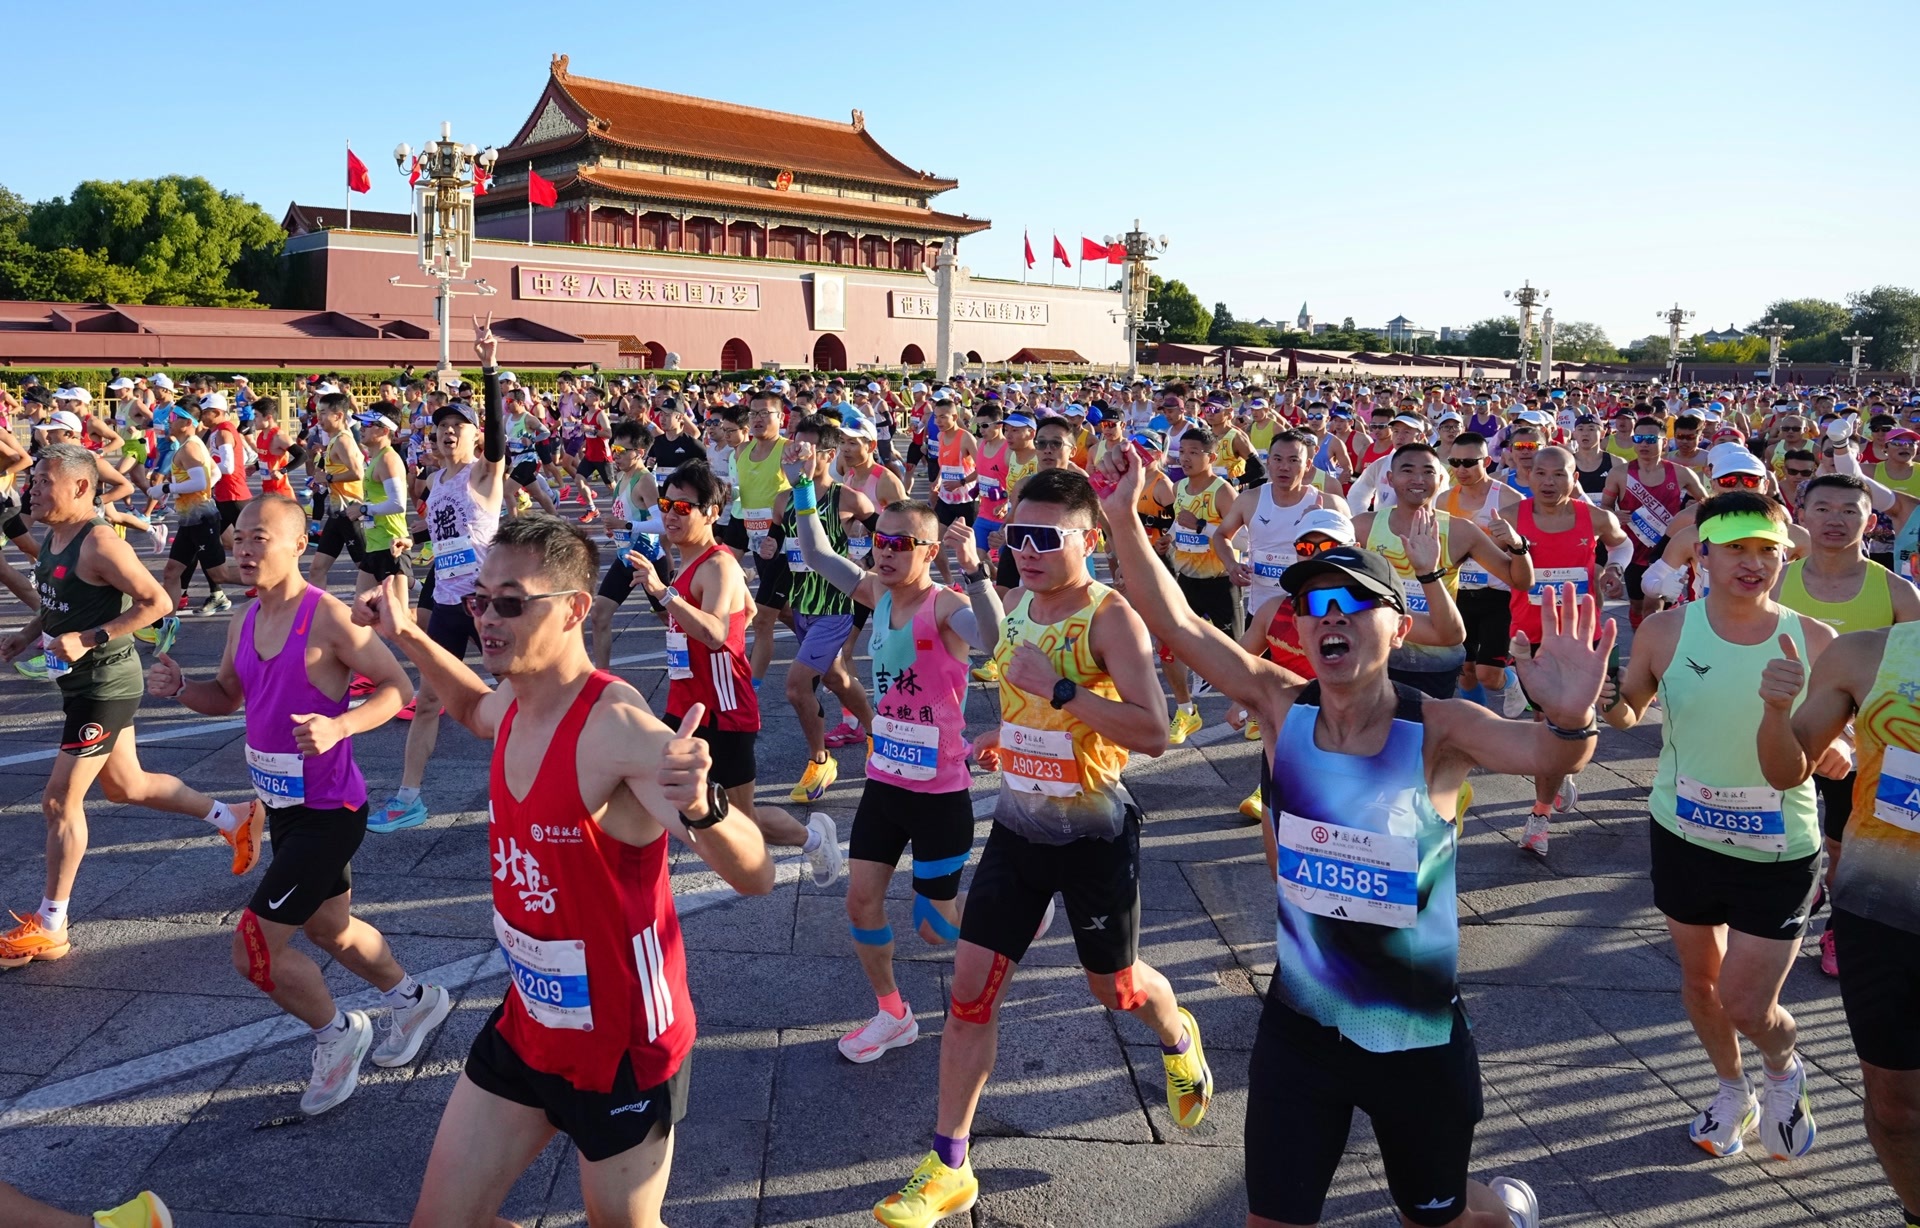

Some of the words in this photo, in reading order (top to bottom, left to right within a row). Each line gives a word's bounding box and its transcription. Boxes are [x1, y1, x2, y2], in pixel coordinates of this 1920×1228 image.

[533, 273, 749, 305] 中华人民共和国万岁
[901, 296, 1041, 322] 世界民大团结万岁
[1632, 483, 1662, 511] SUNSET
[438, 552, 466, 567] A14725
[876, 663, 922, 696] 吉林
[883, 741, 922, 763] A13451
[1012, 755, 1063, 779] A90233
[251, 769, 289, 794] A14764
[544, 825, 581, 837] 中国银行
[1691, 807, 1763, 832] A12633
[1332, 829, 1374, 847] 中国银行
[1296, 858, 1388, 897] A13585
[610, 1100, 643, 1116] saucony
